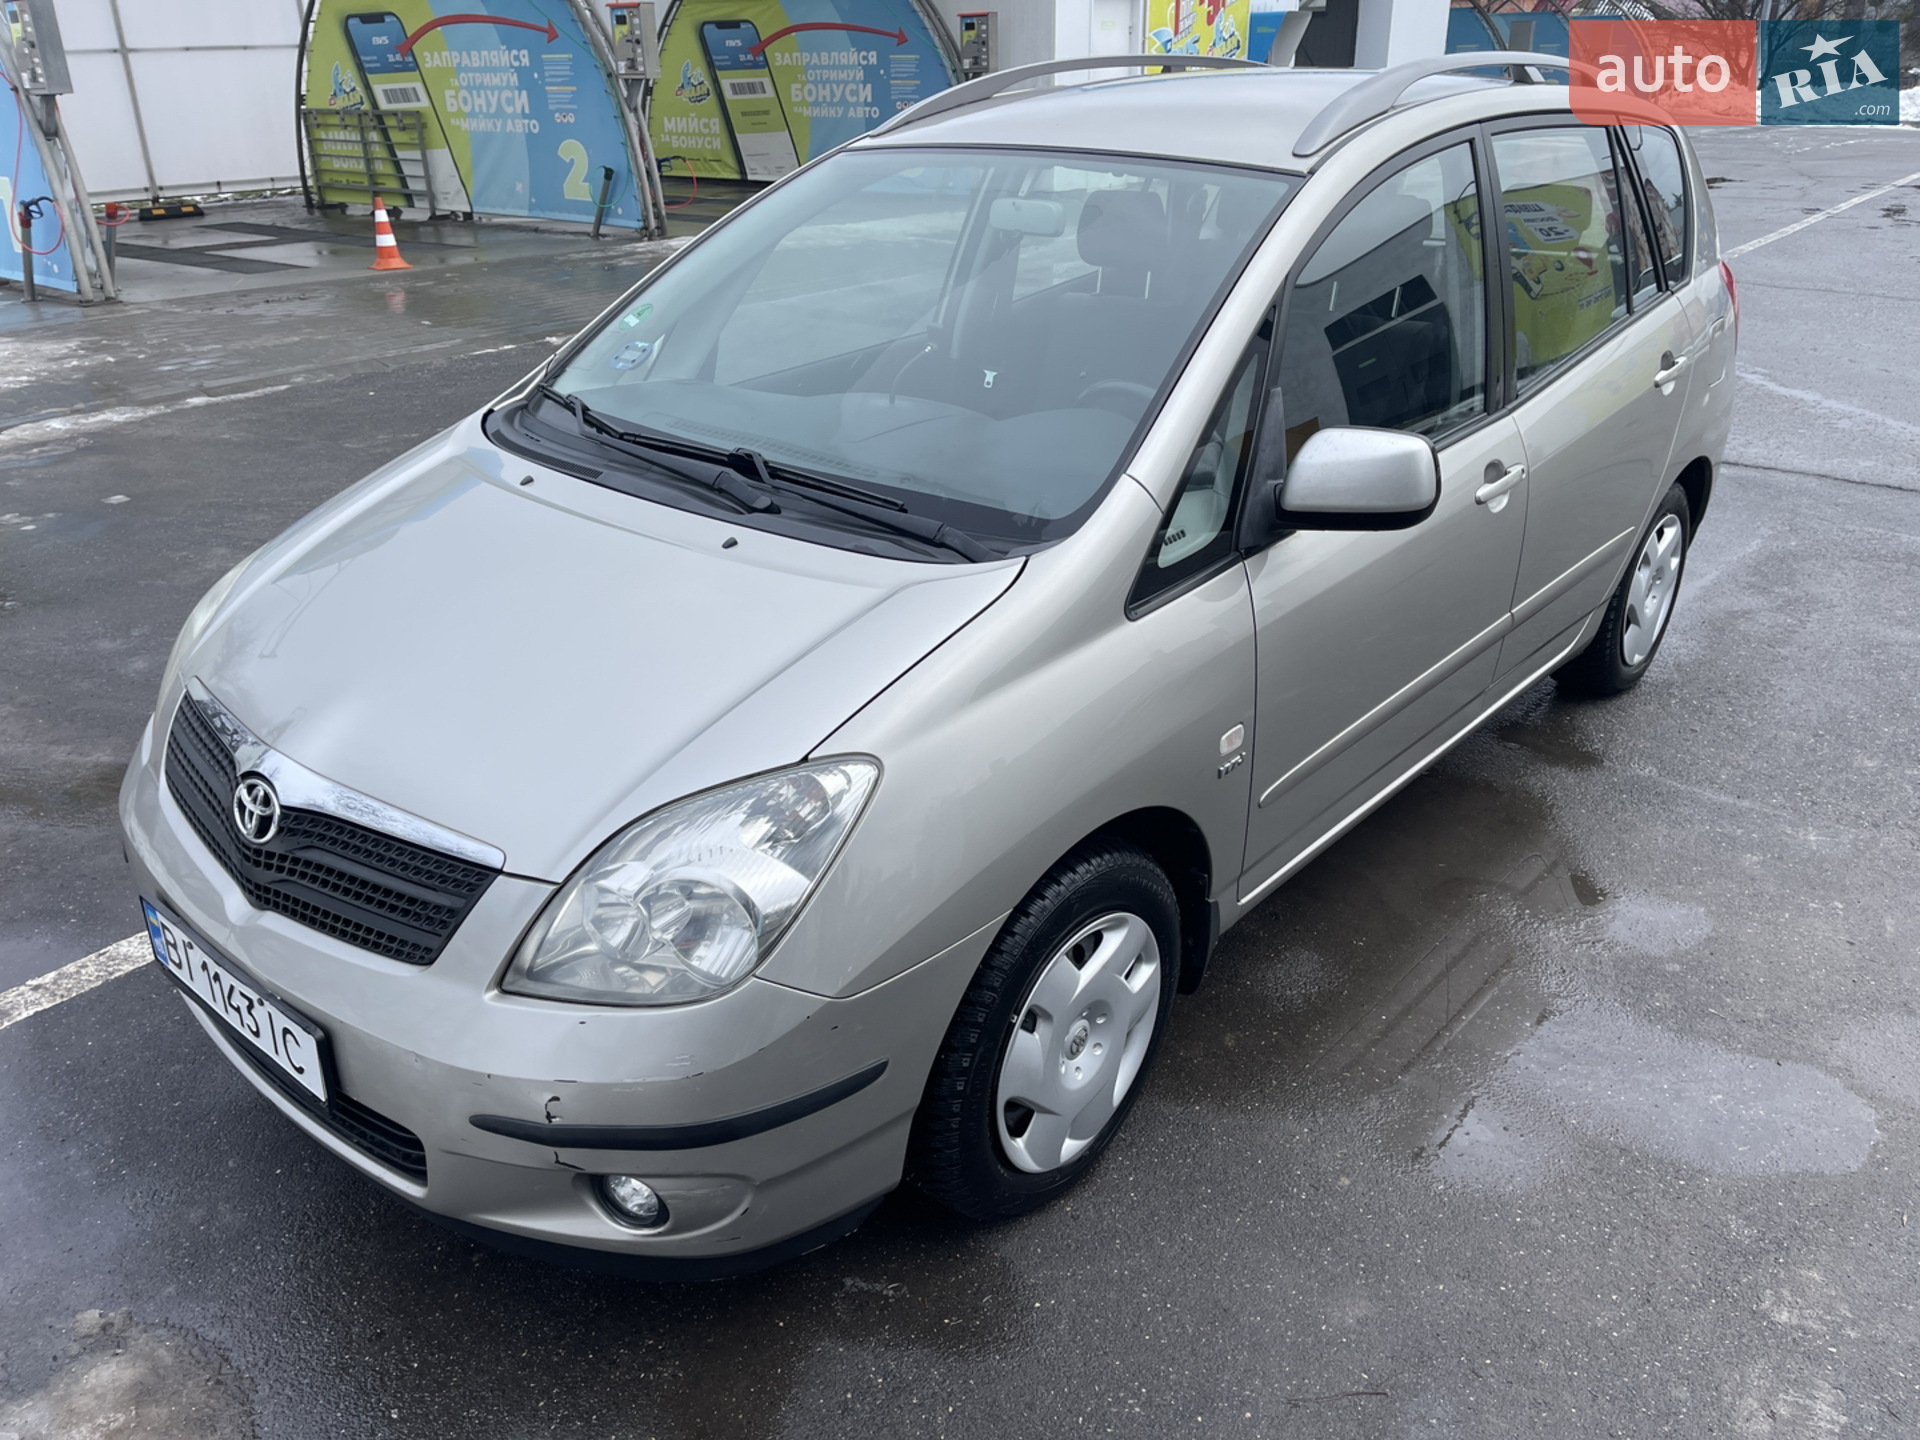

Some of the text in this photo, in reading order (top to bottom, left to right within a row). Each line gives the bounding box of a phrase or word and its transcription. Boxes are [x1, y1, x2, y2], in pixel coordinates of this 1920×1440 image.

[423, 45, 530, 68] ЗАПРАВЛЯЙСЯ
[774, 48, 878, 66] ЗАПРАВЛЯЙСЯ
[459, 68, 519, 87] ОТРИМУЙ
[807, 66, 864, 81] ОТРИМУЙ
[444, 89, 530, 114] БОНУСИ
[791, 83, 873, 103] БОНУСИ
[803, 103, 844, 118] МИЙКУ
[847, 106, 880, 119] АВТО
[461, 114, 502, 132] МИЙКУ
[506, 119, 540, 134] АВТО
[663, 112, 720, 135] МИЙСЯ
[671, 135, 721, 150] БОНУСИ
[557, 139, 593, 201] 2
[200, 959, 261, 1040] 1143
[266, 1009, 306, 1076] IC
